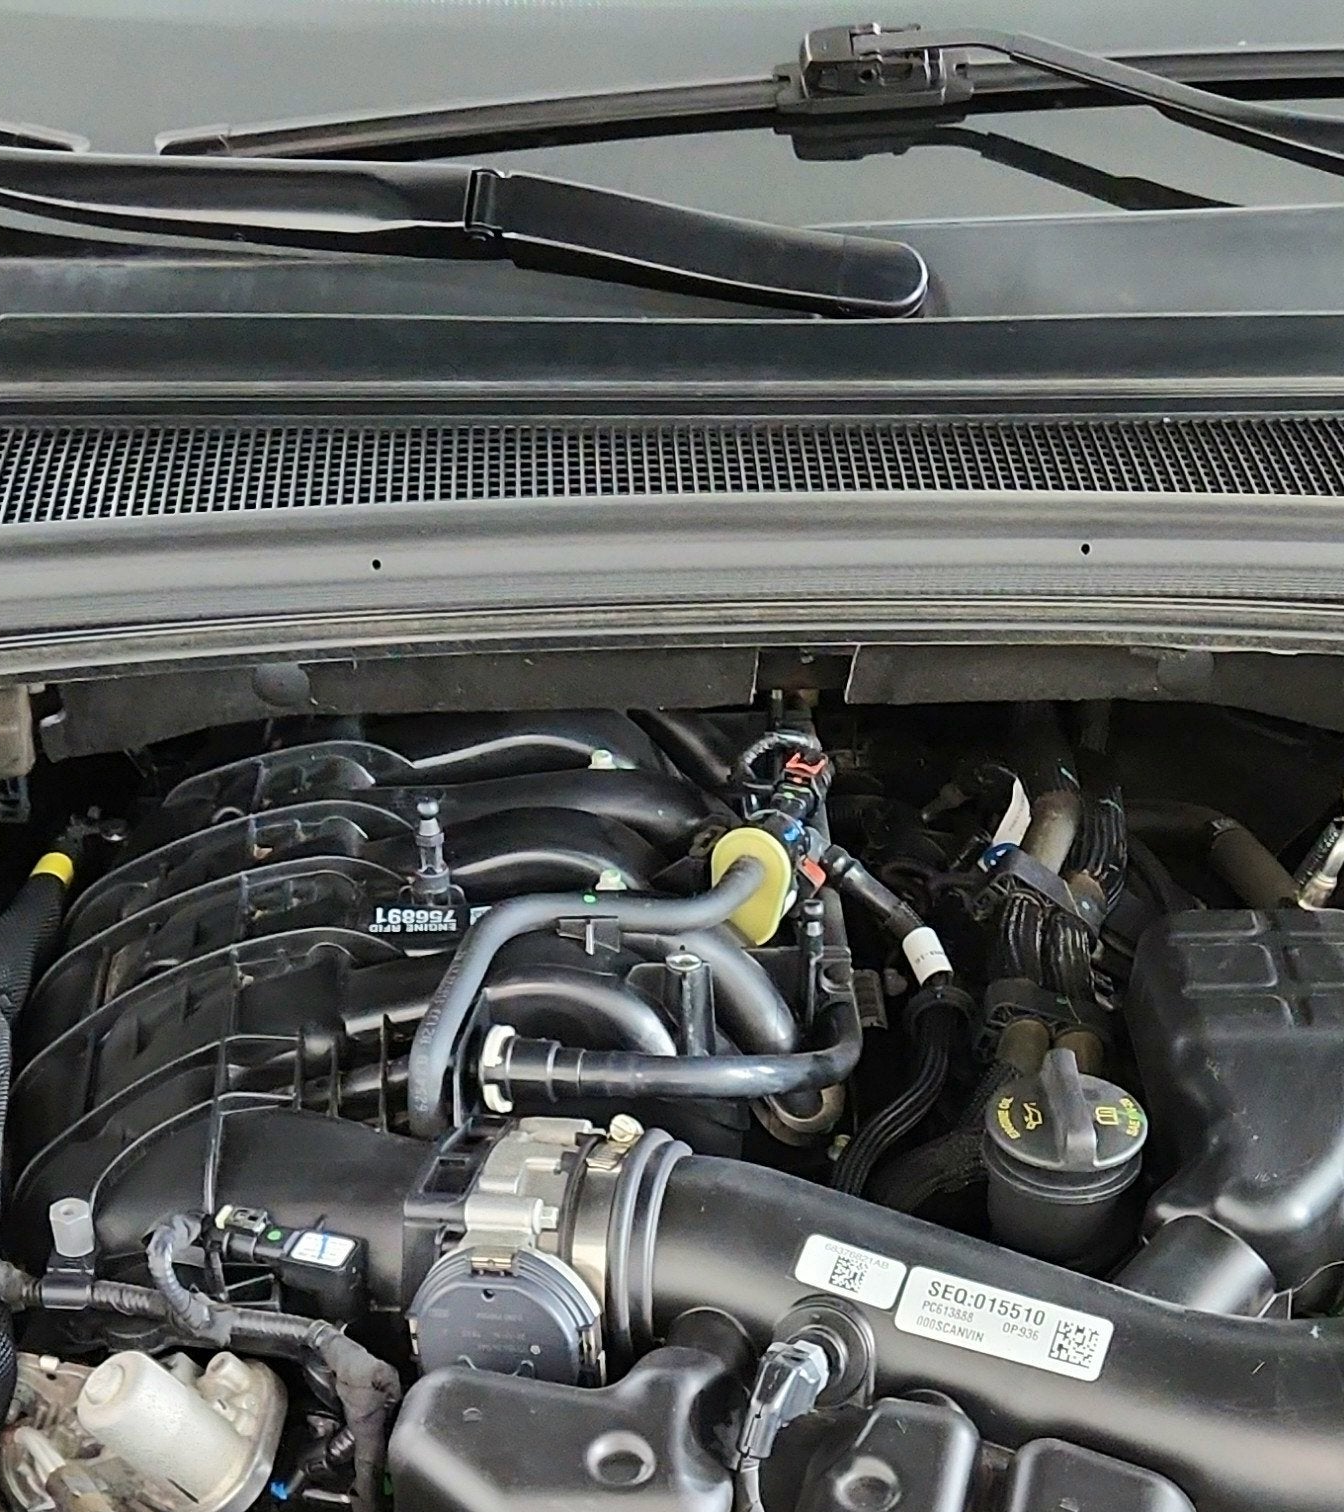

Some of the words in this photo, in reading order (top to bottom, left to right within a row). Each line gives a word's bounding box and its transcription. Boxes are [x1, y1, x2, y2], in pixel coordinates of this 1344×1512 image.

[375, 907, 457, 924] 756891
[368, 923, 402, 933] RFID
[405, 923, 457, 932] ENGINE
[921, 1300, 974, 1323] PC613888
[927, 1280, 1046, 1326] SEQ:015510
